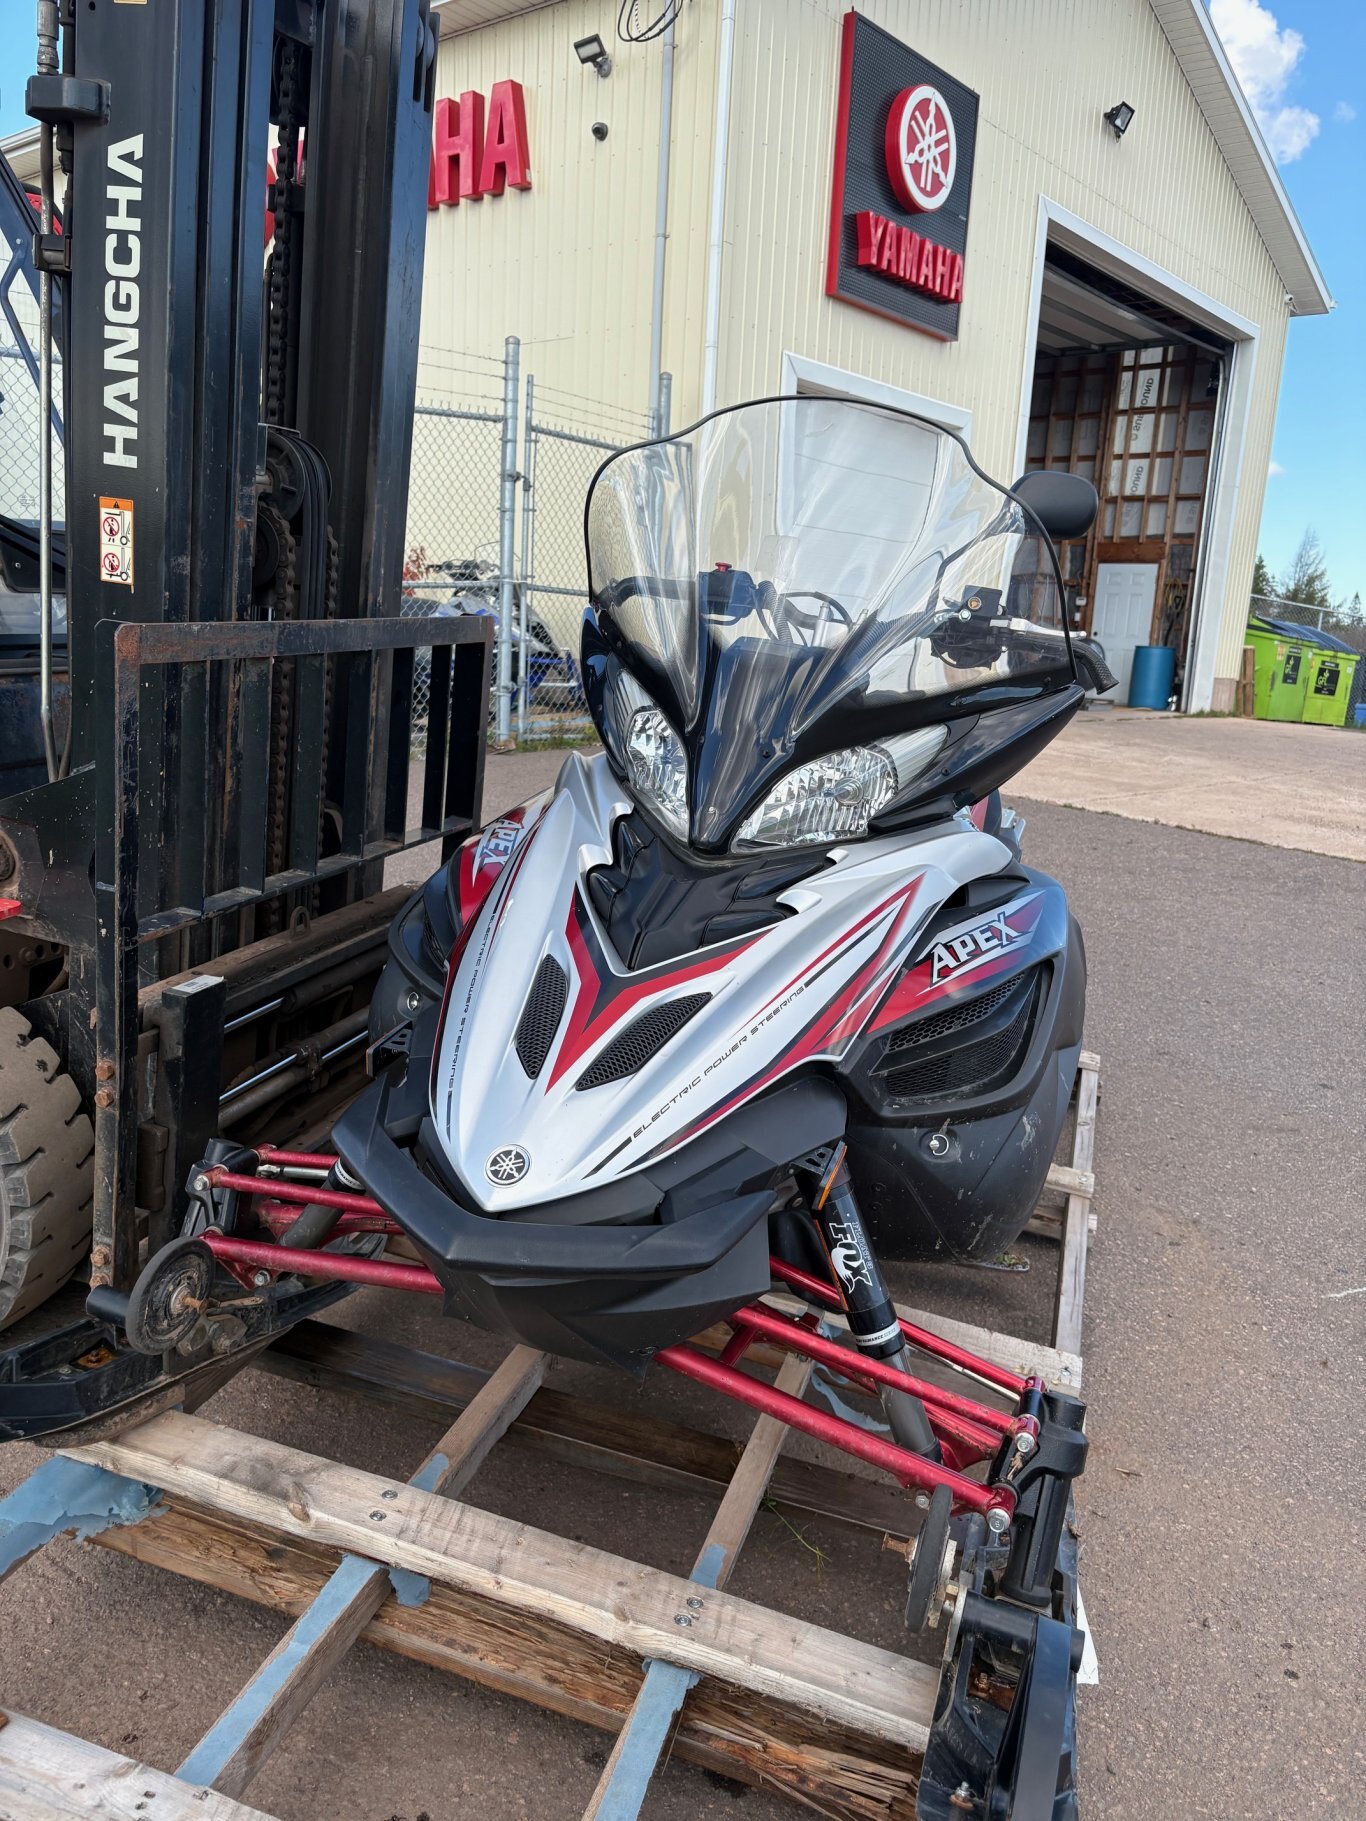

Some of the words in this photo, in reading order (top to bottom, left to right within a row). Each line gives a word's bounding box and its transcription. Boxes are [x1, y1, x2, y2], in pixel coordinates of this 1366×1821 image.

[857, 211, 963, 304] YAMAHA
[103, 133, 144, 469] HANGCHA
[482, 818, 524, 866] APEX
[475, 913, 495, 967] ELECTRIC
[929, 910, 1023, 987] APEX
[464, 969, 479, 1013] POWER
[448, 1017, 466, 1089] STEERING
[633, 1075, 702, 1139] ELECTRIC
[703, 1035, 748, 1076] POWER
[750, 984, 805, 1035] STEERING
[829, 1222, 873, 1289] FOX
